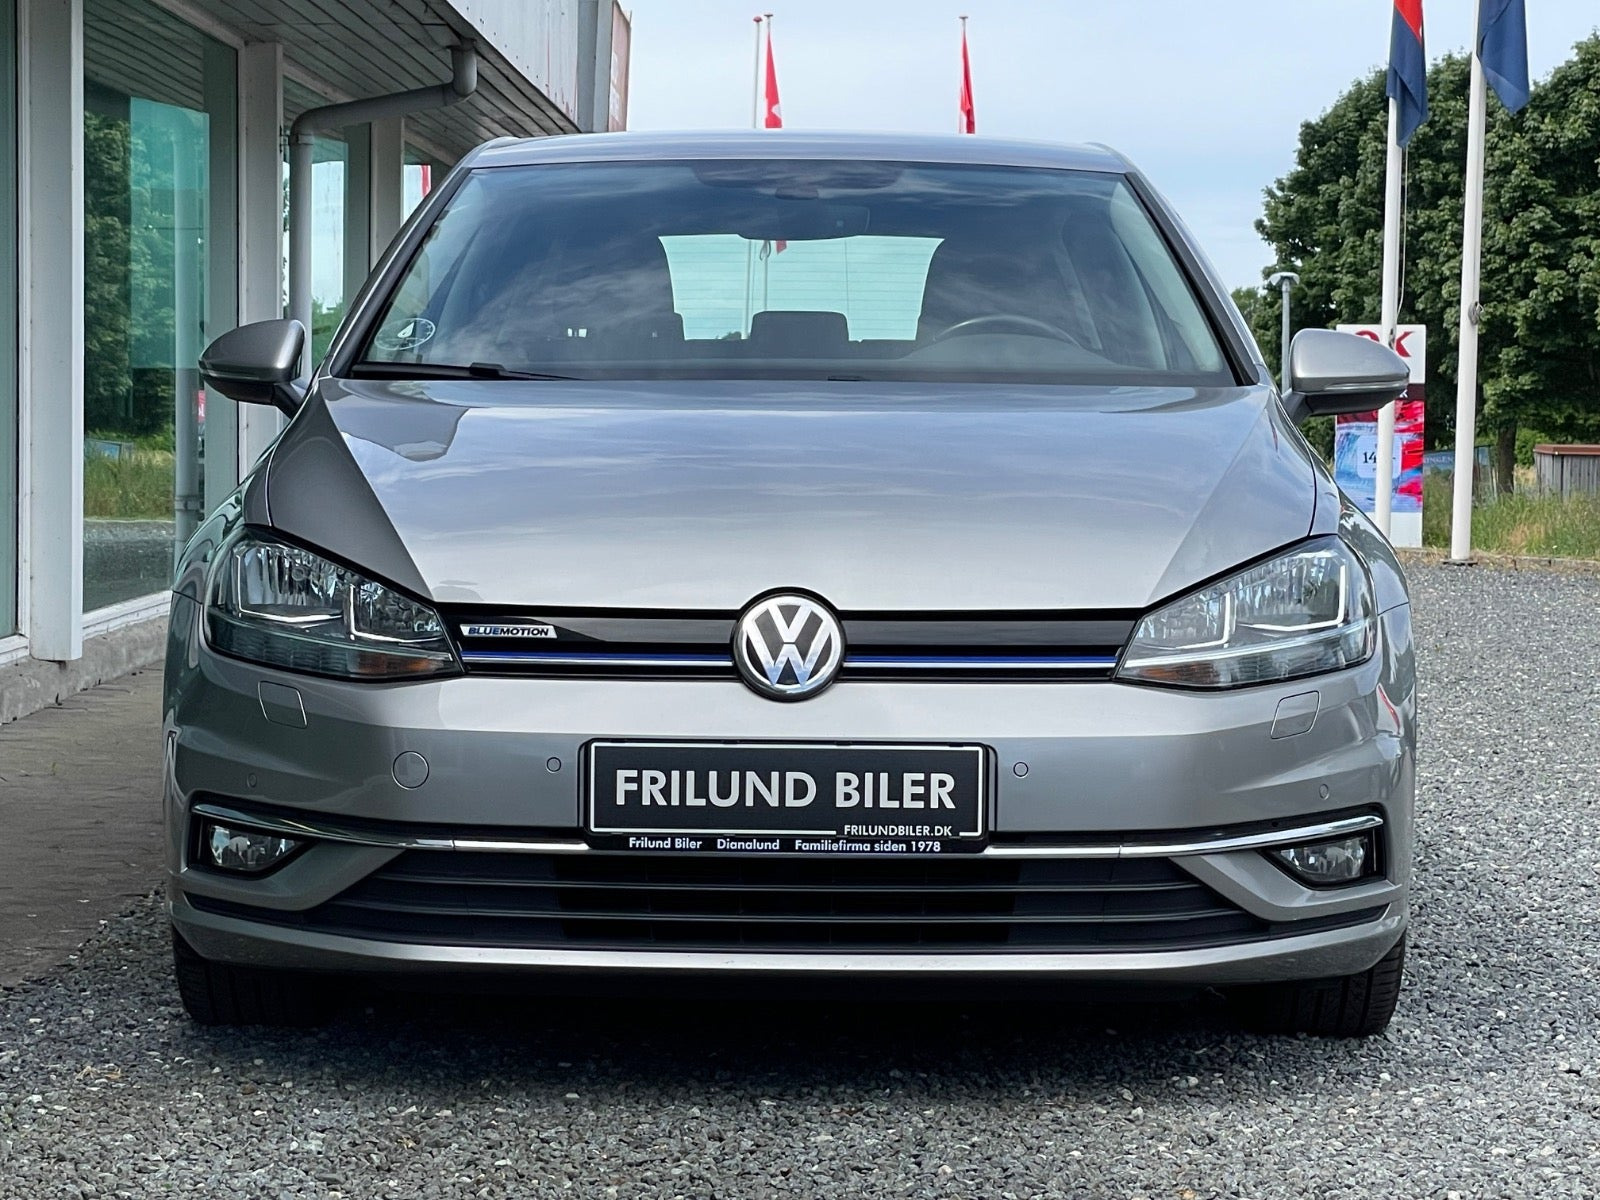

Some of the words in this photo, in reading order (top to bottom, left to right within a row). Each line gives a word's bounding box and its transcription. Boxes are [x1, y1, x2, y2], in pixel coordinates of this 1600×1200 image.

[468, 626, 549, 637] BLUEMOTION
[615, 769, 817, 808] FRILUND
[835, 772, 956, 809] BILER
[844, 824, 952, 836] FRILUNDBILER.DK
[629, 837, 671, 849] Frilund
[675, 837, 702, 849] Biler
[717, 838, 780, 850] Dianalund
[795, 840, 870, 851] Familiefirma
[874, 840, 906, 852] siden
[911, 841, 941, 852] 1978
